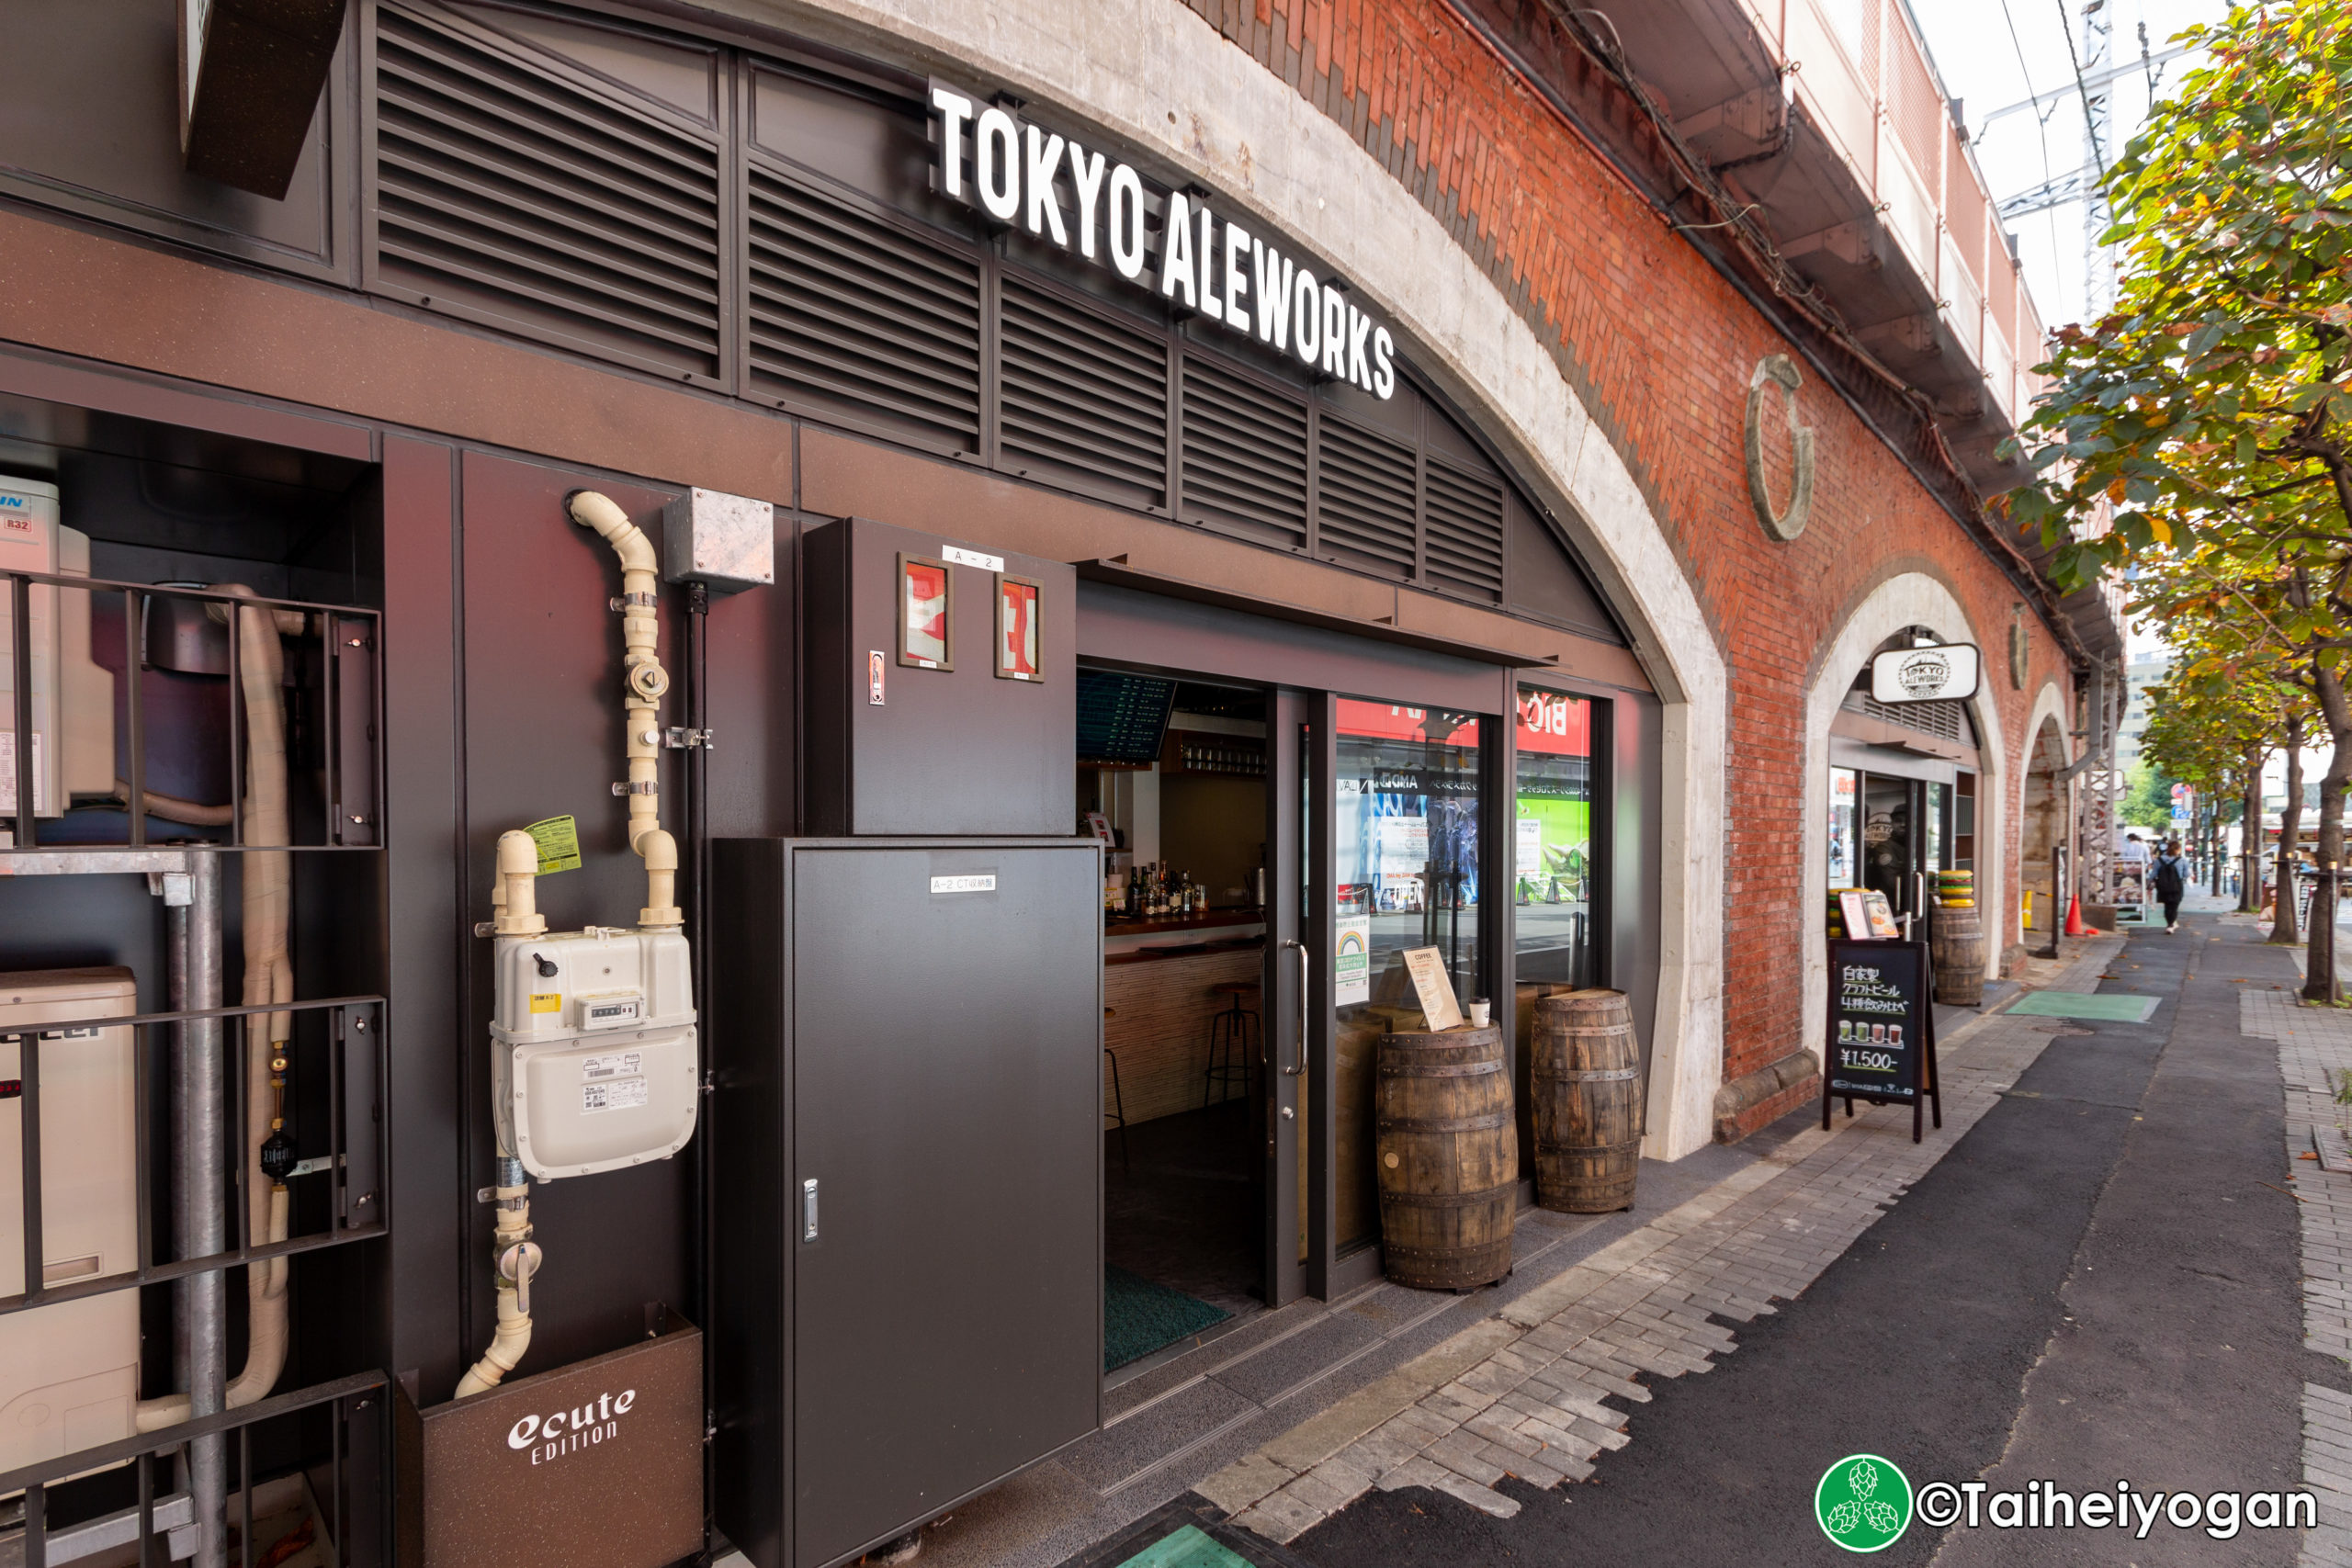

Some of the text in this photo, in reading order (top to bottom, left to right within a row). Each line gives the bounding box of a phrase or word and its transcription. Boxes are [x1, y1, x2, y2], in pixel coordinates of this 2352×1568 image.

[932, 86, 1396, 401] TOKYO ALEWORKS
[7, 519, 28, 530] R32
[1904, 666, 1944, 678] TOKYO
[1905, 674, 1944, 685] ALEWORKS
[933, 879, 954, 889] A-2
[1415, 953, 1432, 961] COFFEE
[1842, 964, 1880, 982] 自家製
[1842, 982, 1901, 997] クラフトビール
[1841, 997, 1910, 1012] 4種飲み比べ
[507, 1388, 637, 1450] ecute
[531, 1420, 617, 1466] EDITION
